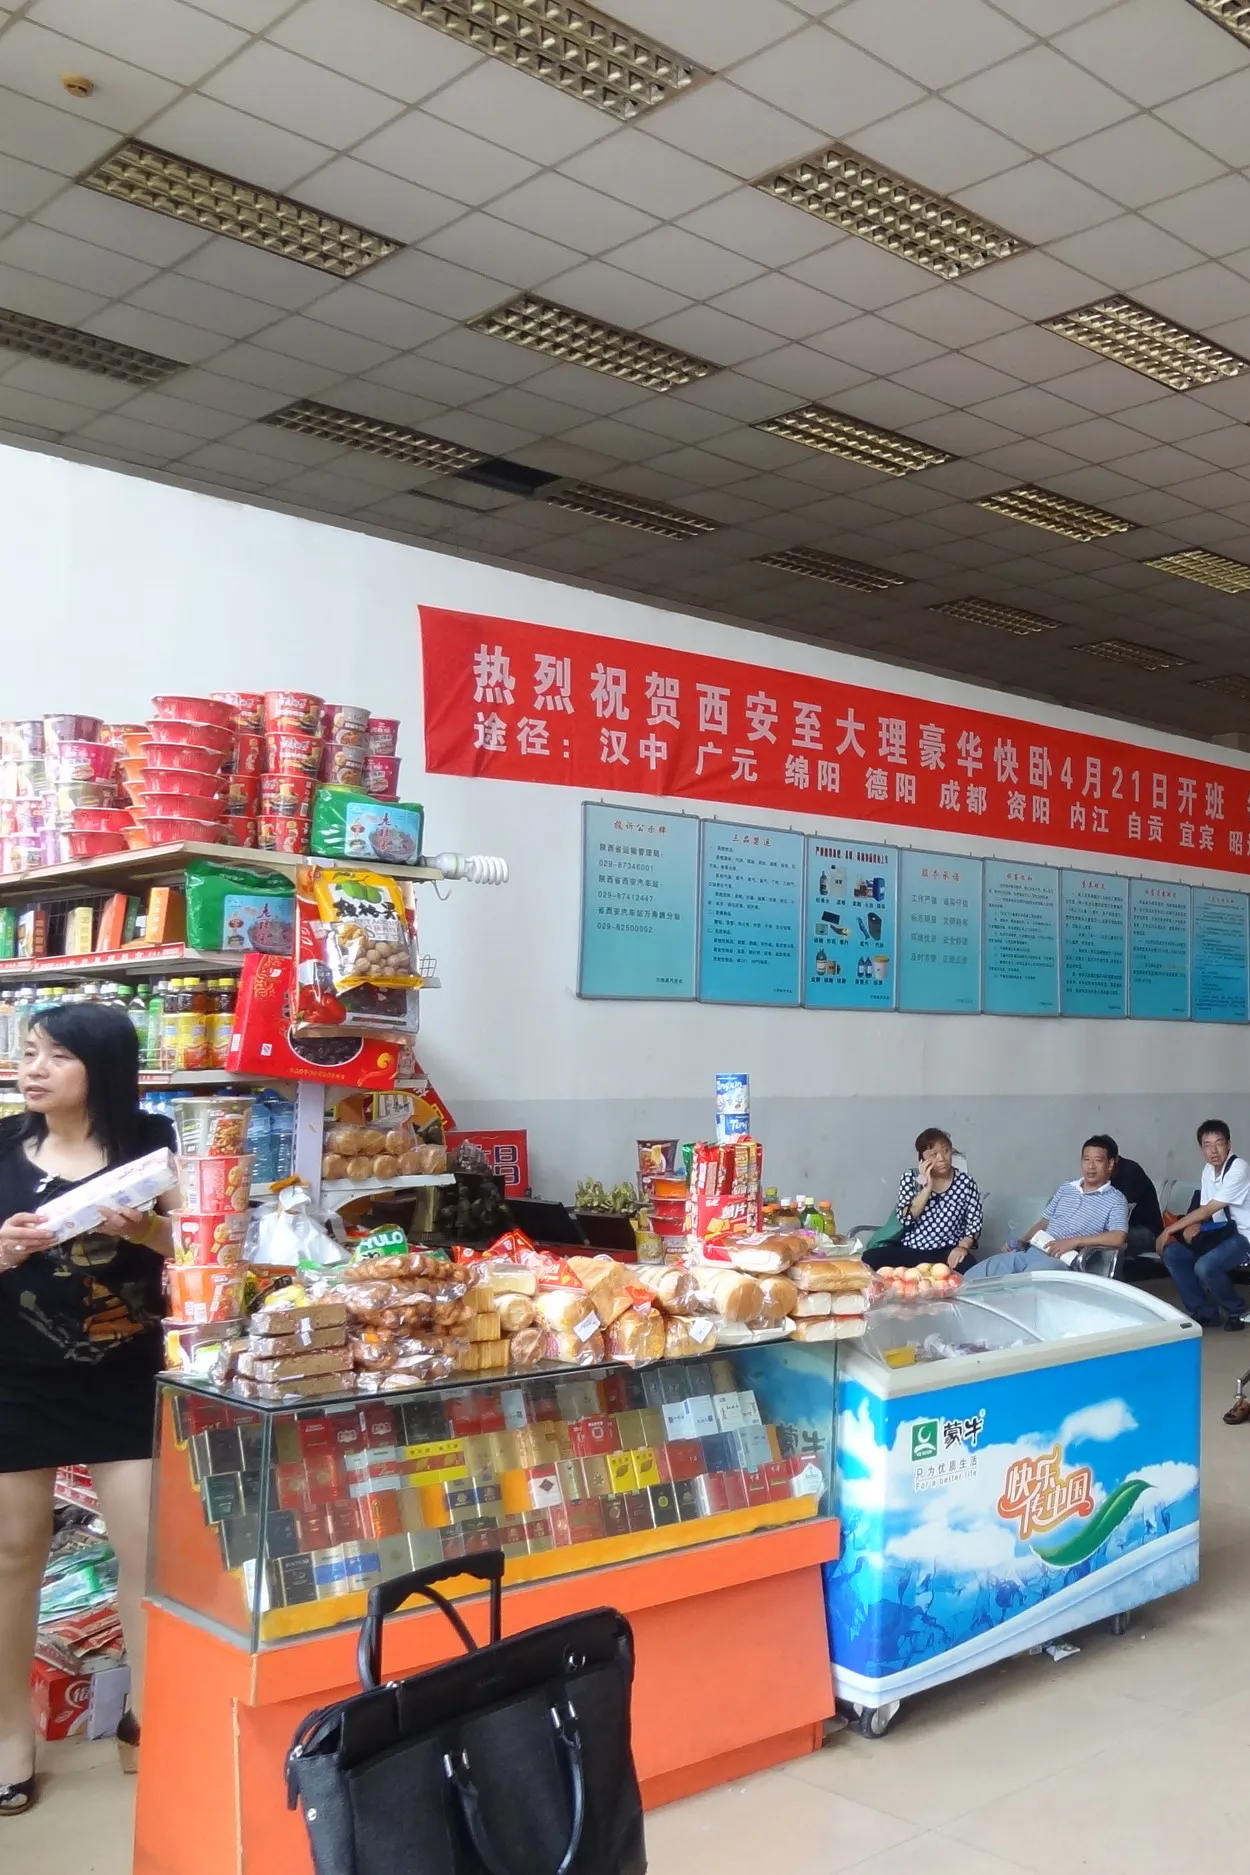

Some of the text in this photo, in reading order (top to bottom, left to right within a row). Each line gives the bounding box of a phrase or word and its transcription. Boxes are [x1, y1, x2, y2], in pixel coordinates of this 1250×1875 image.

[599, 730, 668, 771] 汉中
[696, 742, 758, 782] 广元
[784, 754, 841, 794] 绵阳
[865, 766, 917, 804] 德阳
[939, 777, 988, 815] 成都
[1006, 790, 1051, 826] 资阳
[1069, 800, 1109, 834] 内江
[1127, 811, 1165, 845] 自贡
[1179, 820, 1215, 853] 宜宾
[944, 1417, 983, 1449] 蒙牛
[915, 1482, 929, 1491] For
[939, 1474, 962, 1485] better
[964, 1469, 977, 1478] life
[916, 1456, 978, 1479] 只为优质生活
